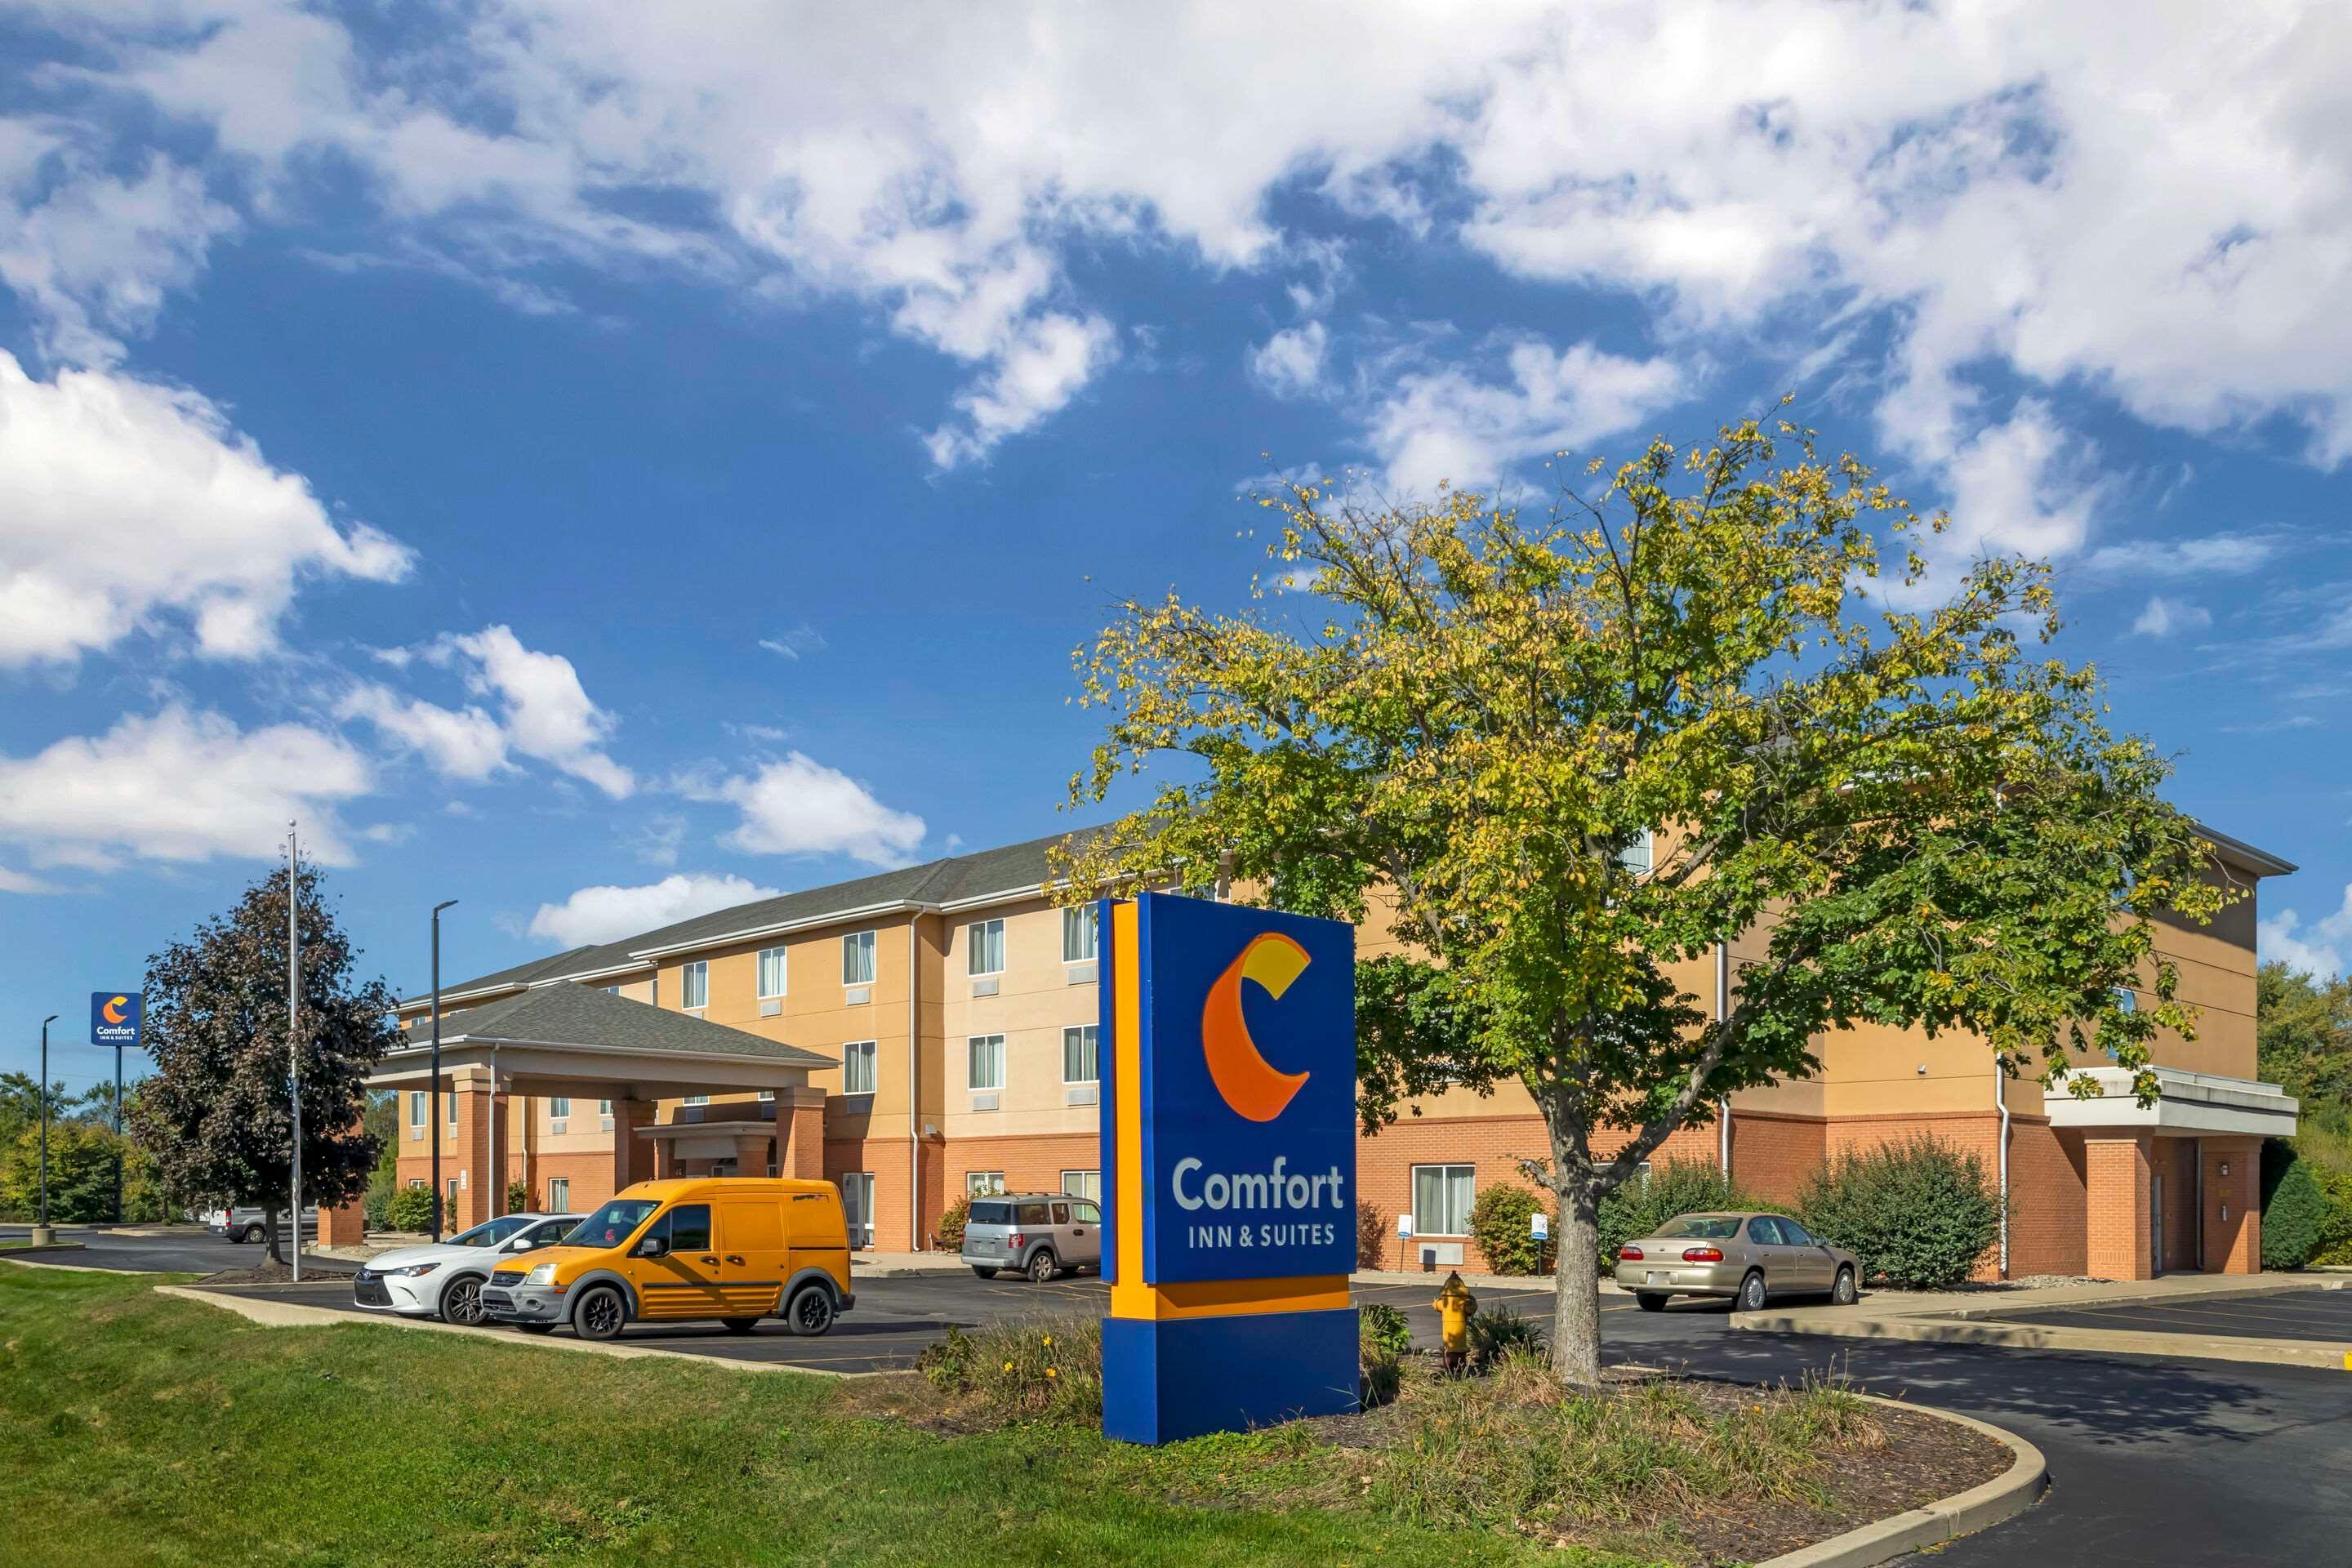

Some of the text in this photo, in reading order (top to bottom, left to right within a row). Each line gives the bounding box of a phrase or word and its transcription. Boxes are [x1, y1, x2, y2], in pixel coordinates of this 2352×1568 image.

[96, 1026, 136, 1036] Comfort
[1172, 1156, 1344, 1210] Comfort
[1188, 1223, 1335, 1249] INN & SUITES
